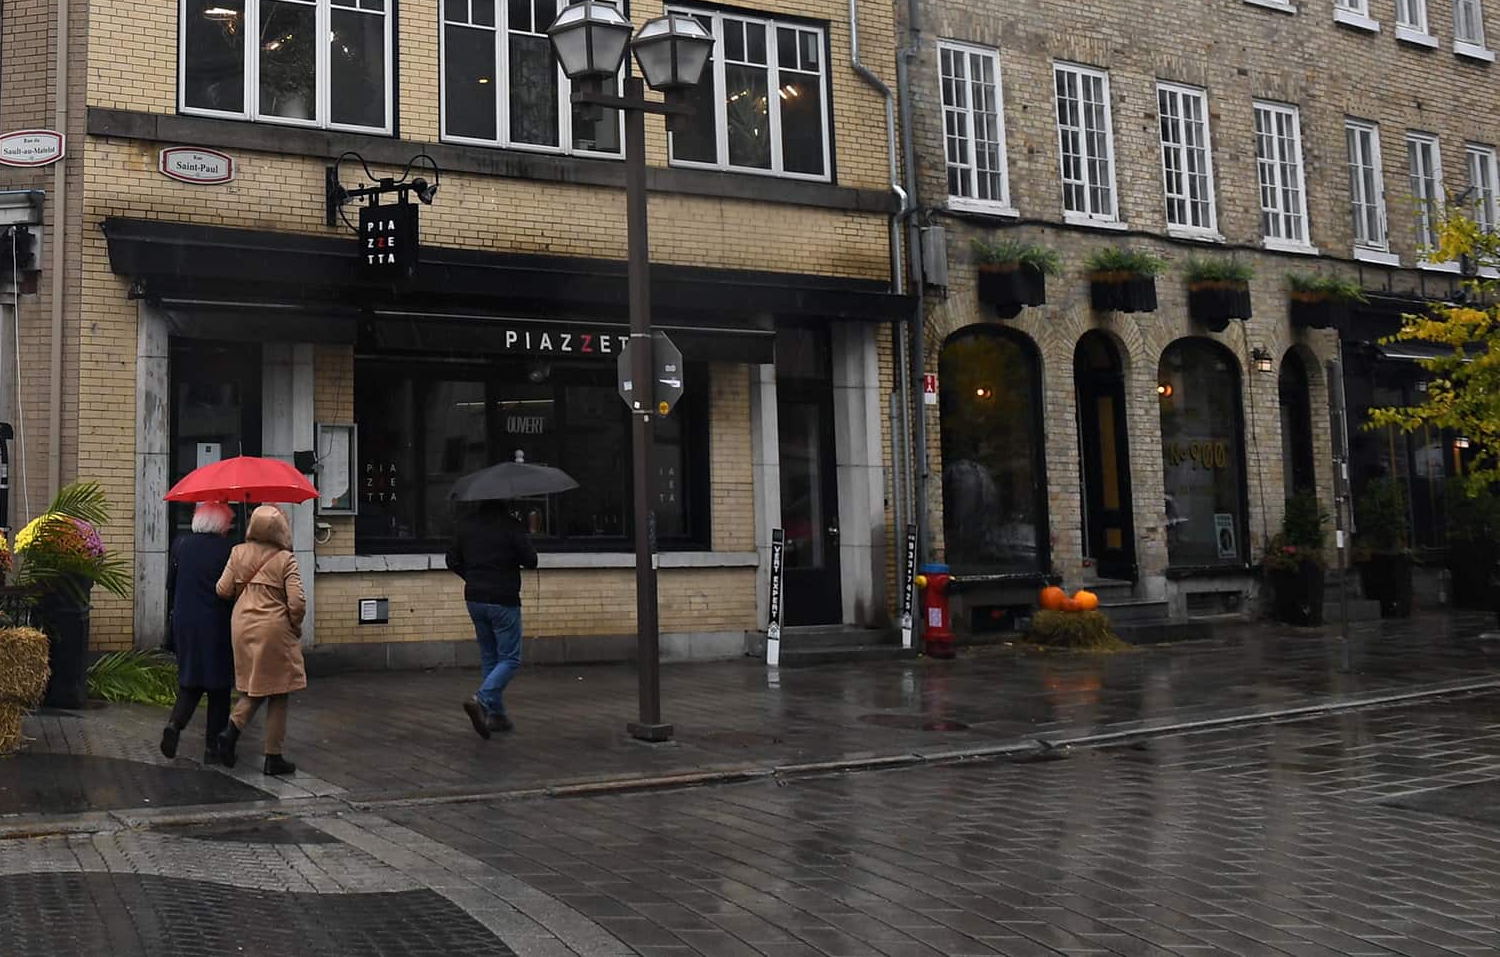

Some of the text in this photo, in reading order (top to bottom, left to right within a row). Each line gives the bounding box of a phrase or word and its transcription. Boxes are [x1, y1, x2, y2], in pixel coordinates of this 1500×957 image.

[176, 161, 219, 174] Saint-Paul
[367, 220, 395, 232] PIA
[367, 236, 395, 249] ZZE
[367, 253, 395, 265] TTA
[506, 416, 545, 435] OUVERT
[366, 463, 396, 473] PIA
